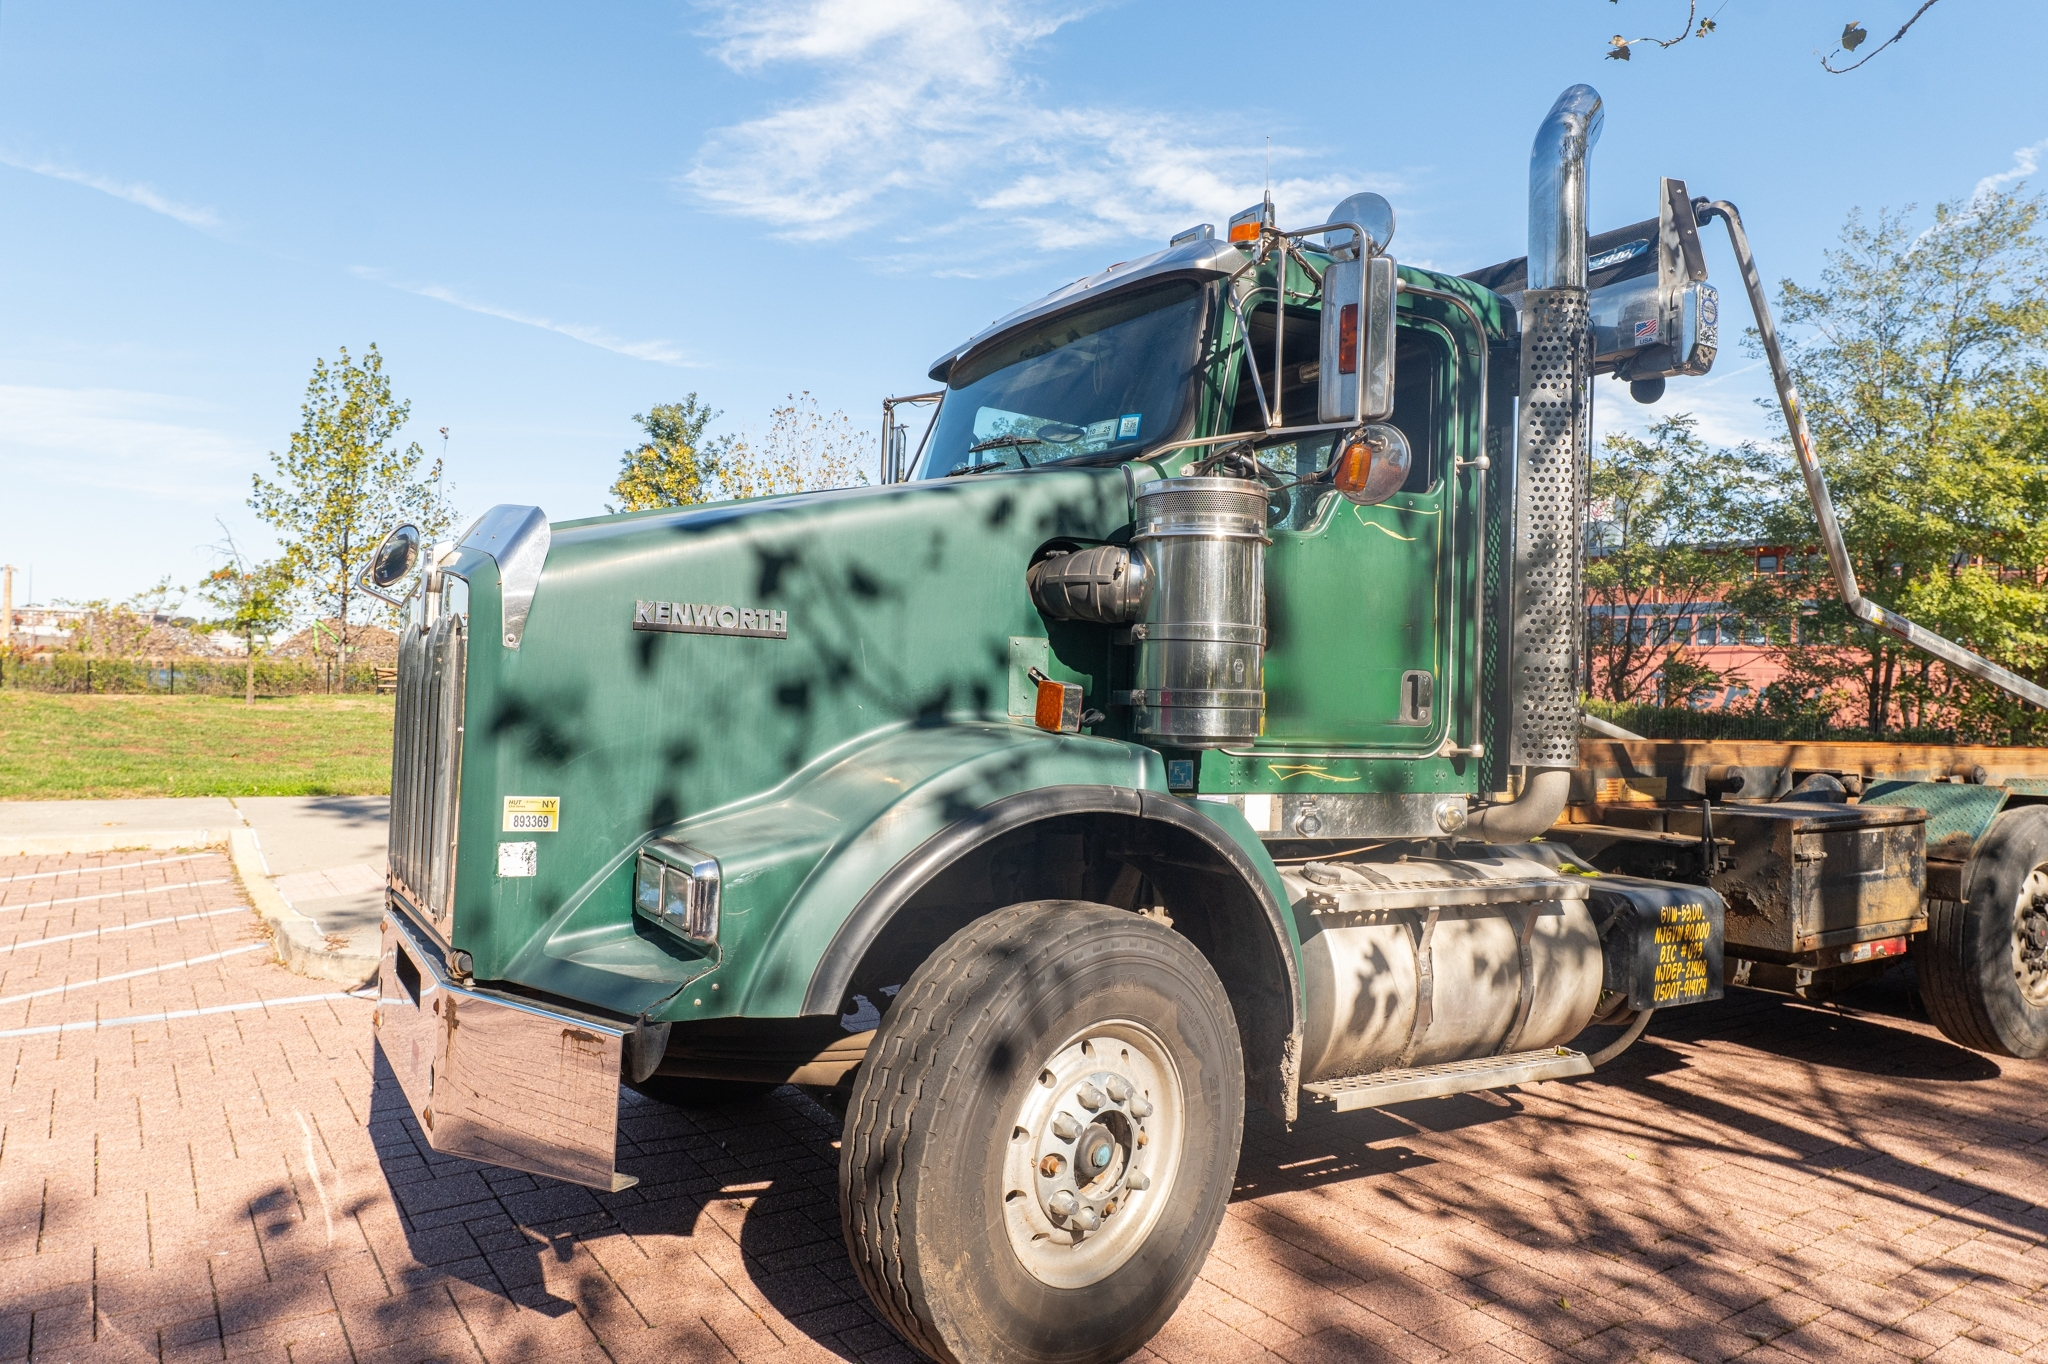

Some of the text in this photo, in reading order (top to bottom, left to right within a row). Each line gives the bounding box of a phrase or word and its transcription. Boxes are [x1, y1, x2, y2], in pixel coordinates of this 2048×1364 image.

[635, 600, 788, 632] KENWORTH
[513, 814, 549, 828] 893369
[1654, 922, 1711, 944] NJGVW 80,000
[1659, 941, 1703, 963] BIC #093
[1073, 973, 1146, 1010] COIN
